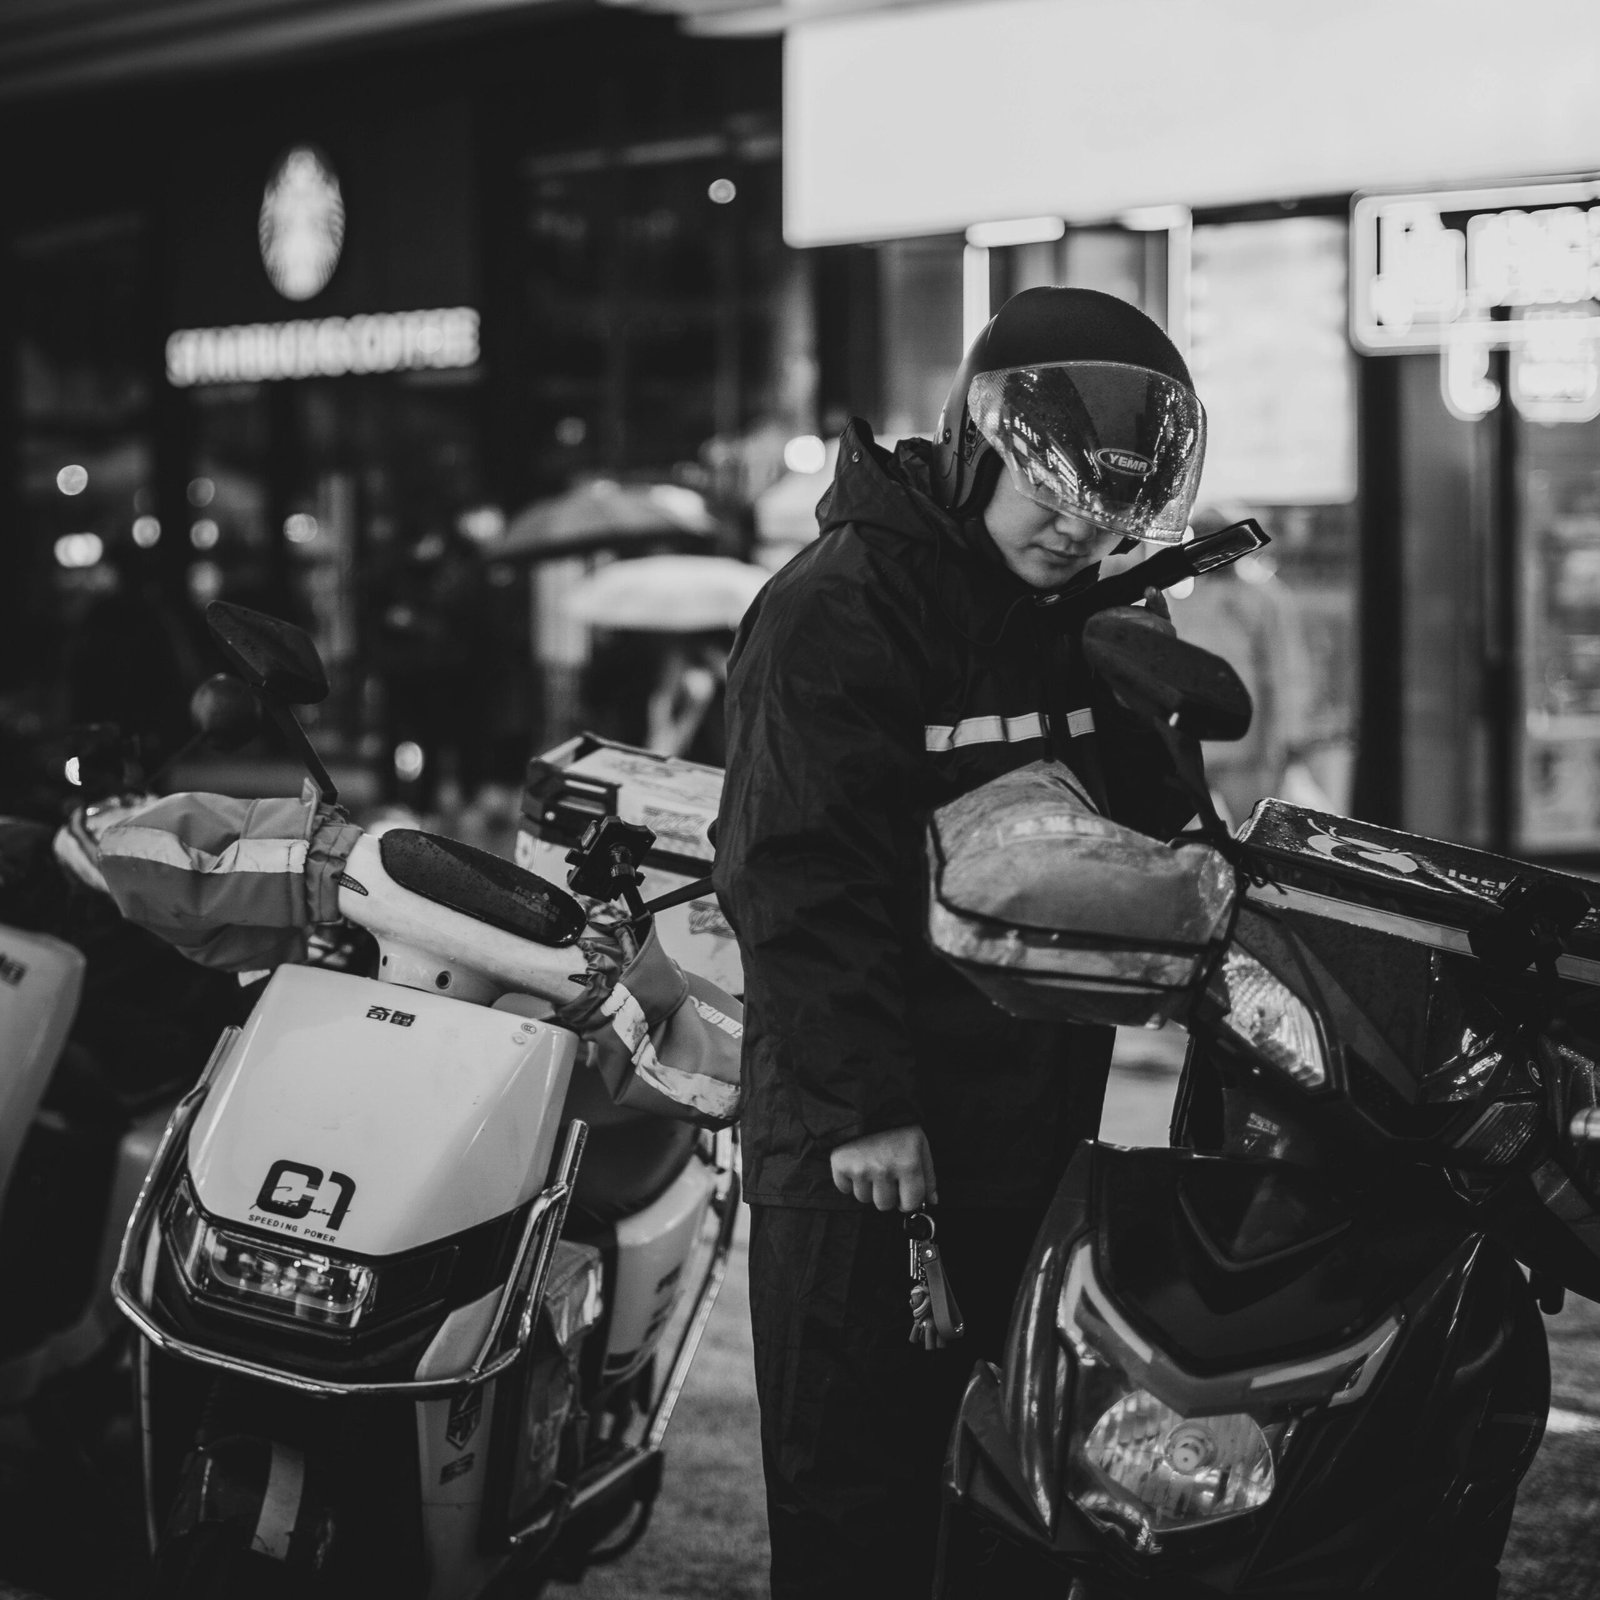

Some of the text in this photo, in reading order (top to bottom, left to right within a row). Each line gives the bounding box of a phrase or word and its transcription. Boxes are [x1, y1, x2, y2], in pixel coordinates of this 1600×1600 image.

[1109, 453, 1148, 472] YEMA
[248, 1214, 337, 1244] SPEEDING POWER
